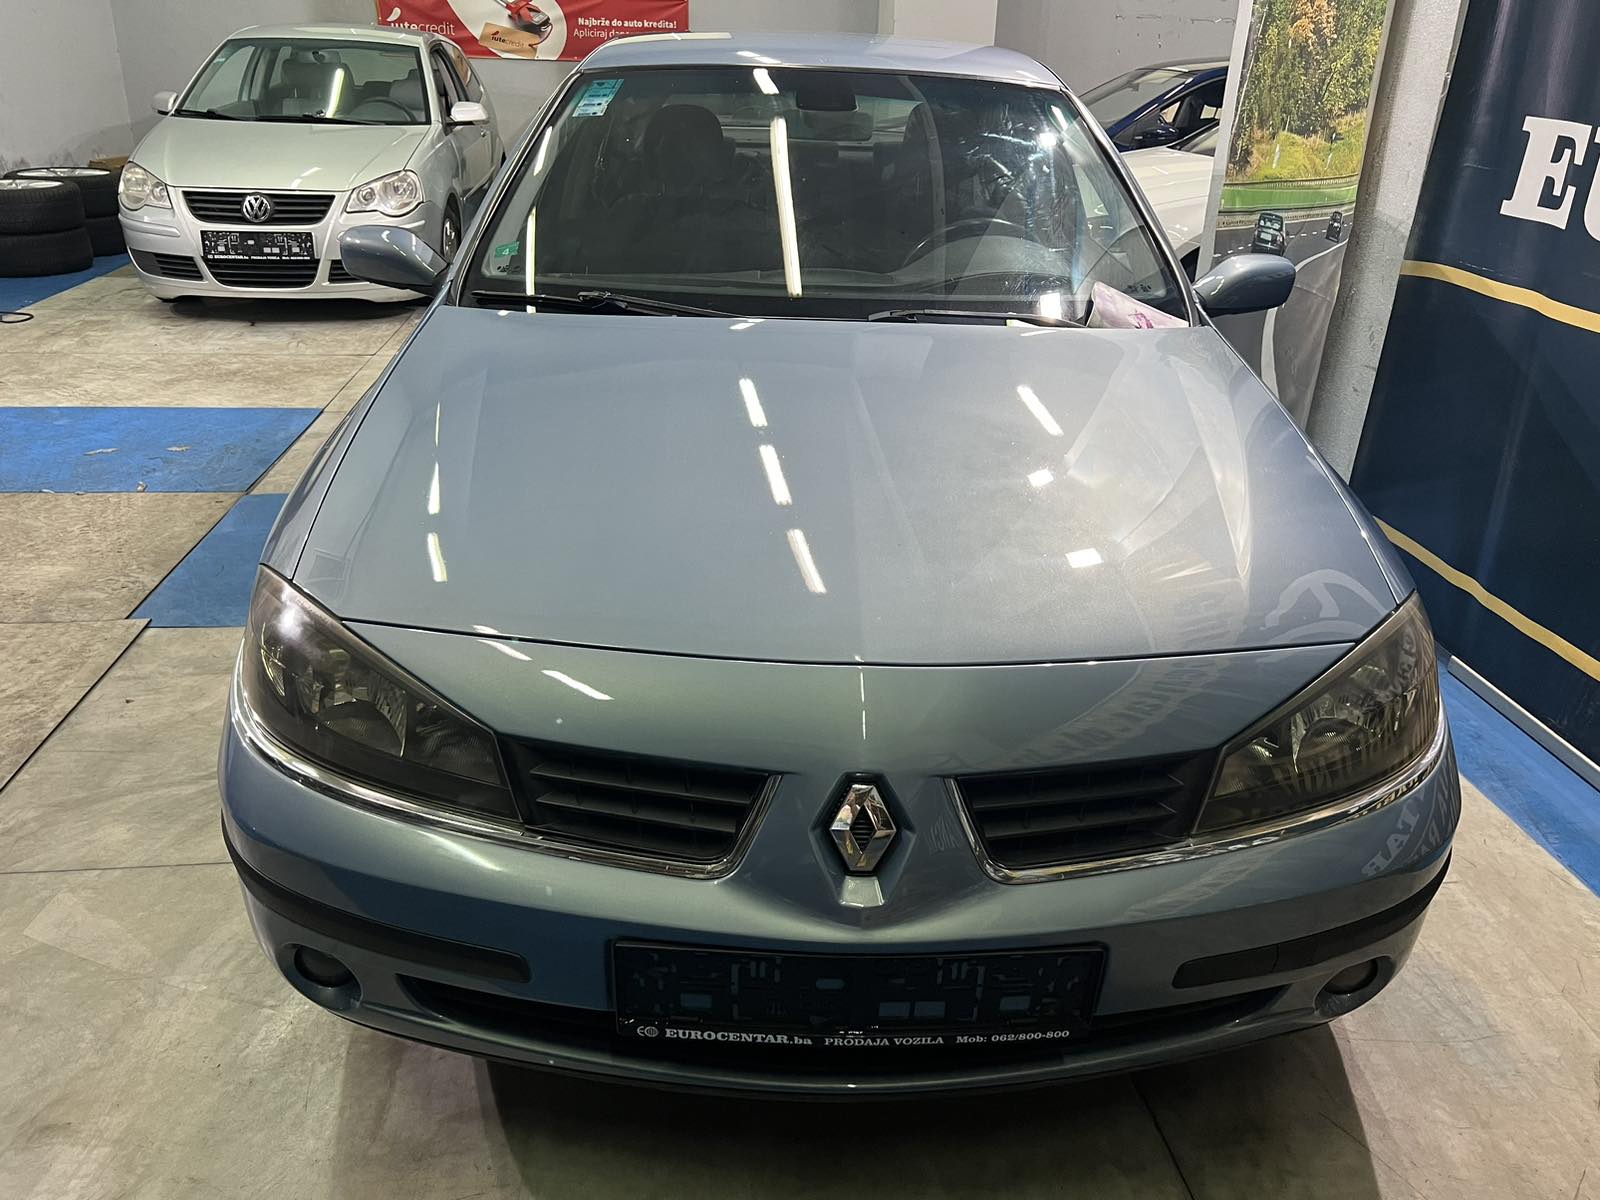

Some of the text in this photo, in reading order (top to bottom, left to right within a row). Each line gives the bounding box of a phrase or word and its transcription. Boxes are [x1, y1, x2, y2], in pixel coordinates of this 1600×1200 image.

[578, 17, 677, 29] Najbrže do auto kredita!
[573, 28, 608, 40] Apliciraj
[664, 1027, 1070, 1047] EUROCENTAR.ba PRODAJA VOZILA Mob: 062/800-800
